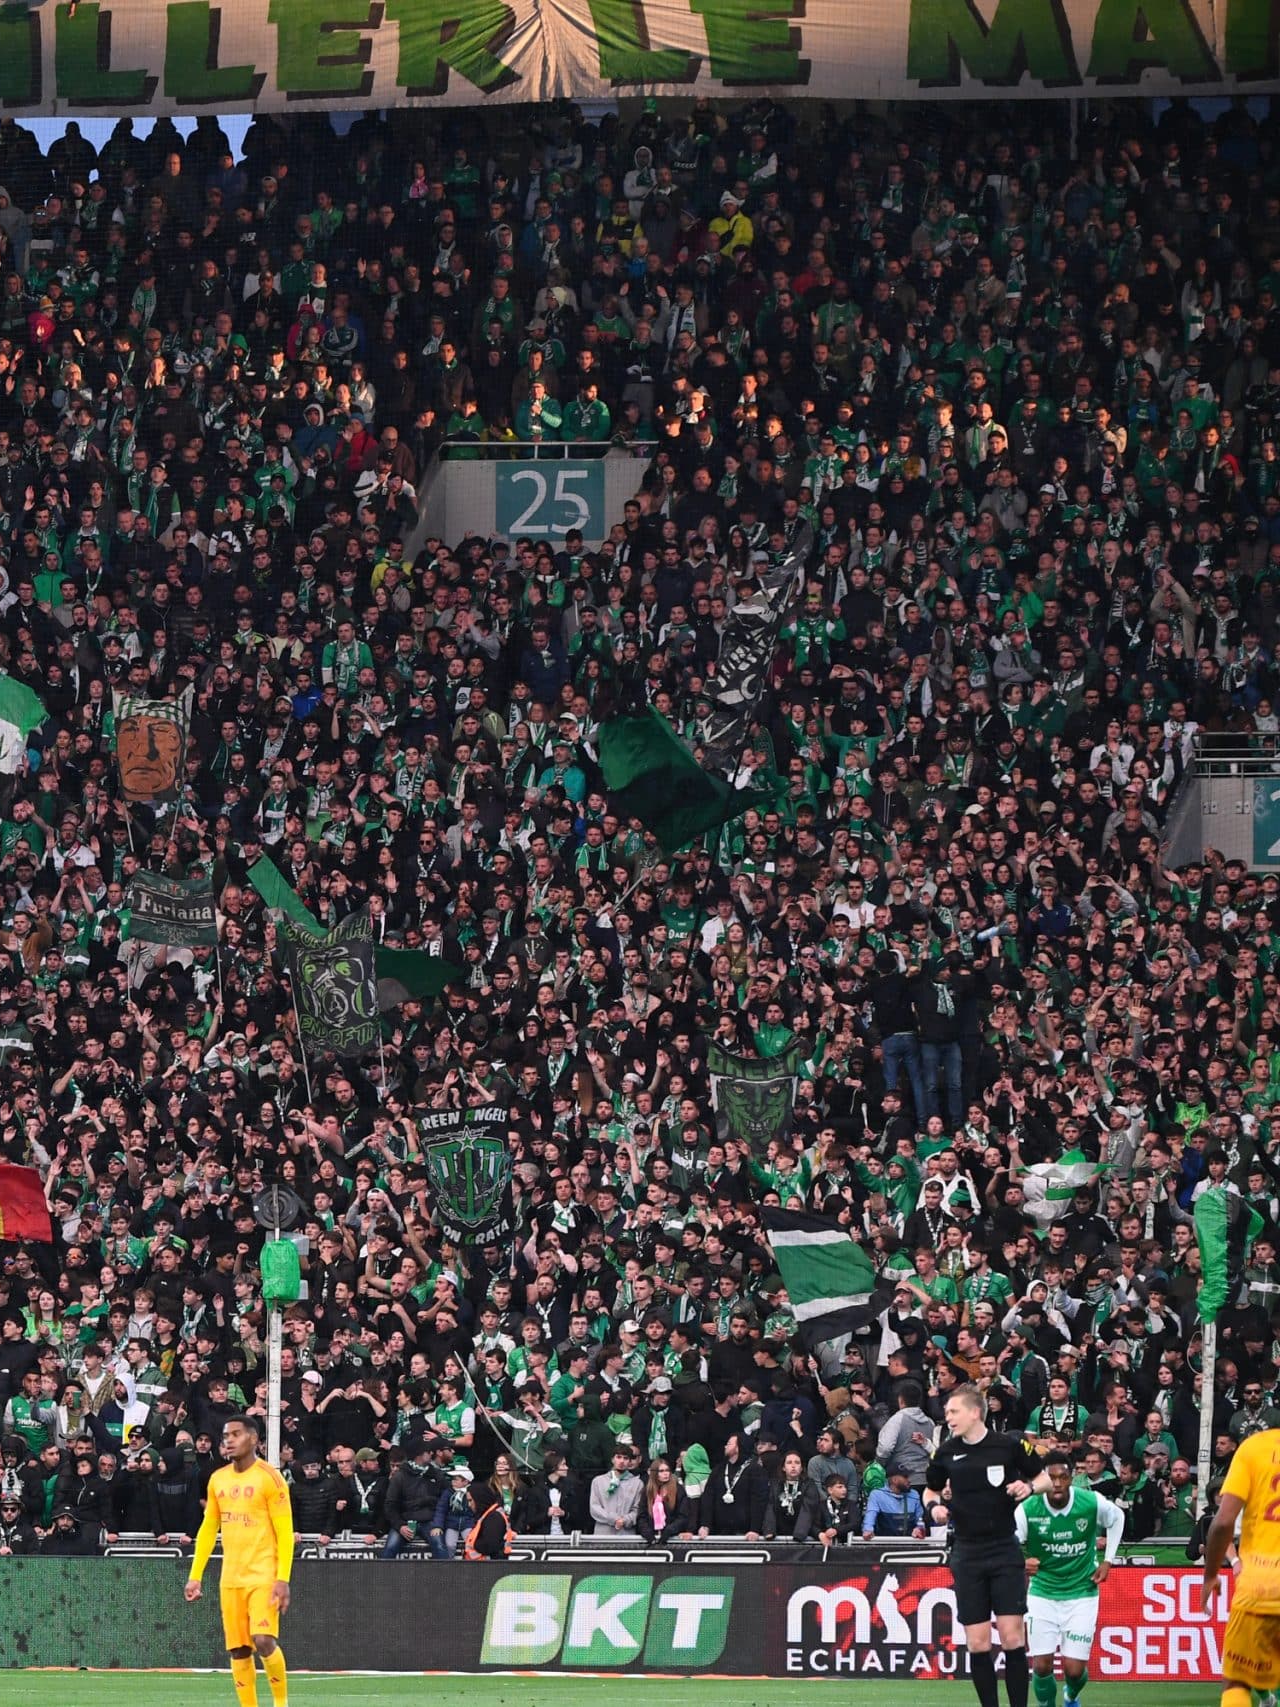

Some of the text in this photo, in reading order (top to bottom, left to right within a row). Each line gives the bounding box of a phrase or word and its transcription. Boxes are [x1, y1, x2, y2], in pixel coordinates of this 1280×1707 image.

[586, 0, 812, 89] LE
[508, 470, 591, 534] 25
[488, 1591, 725, 1649] BKT
